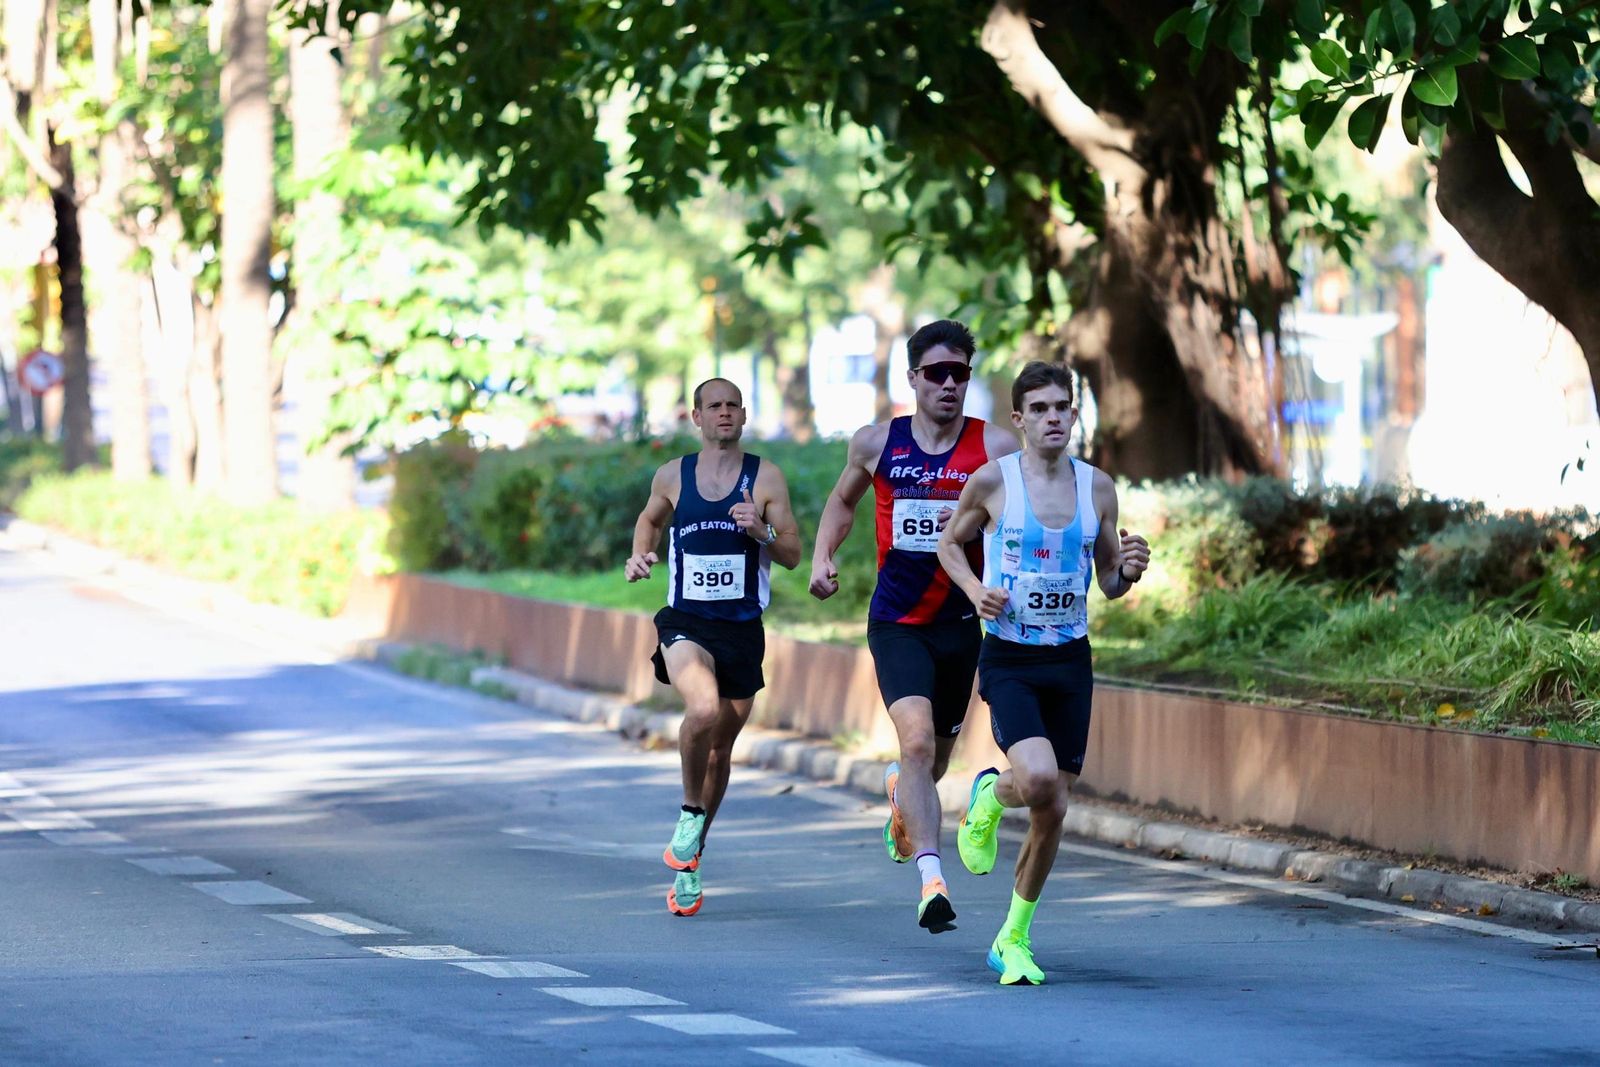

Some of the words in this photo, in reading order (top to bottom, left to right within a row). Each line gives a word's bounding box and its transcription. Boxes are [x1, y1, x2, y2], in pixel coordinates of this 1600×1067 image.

[890, 466, 922, 478] RFC
[937, 467, 971, 482] Lièg
[893, 486, 960, 498] athlétism
[701, 521, 735, 531] EATON
[694, 572, 734, 586] 390
[1028, 592, 1075, 609] 330
